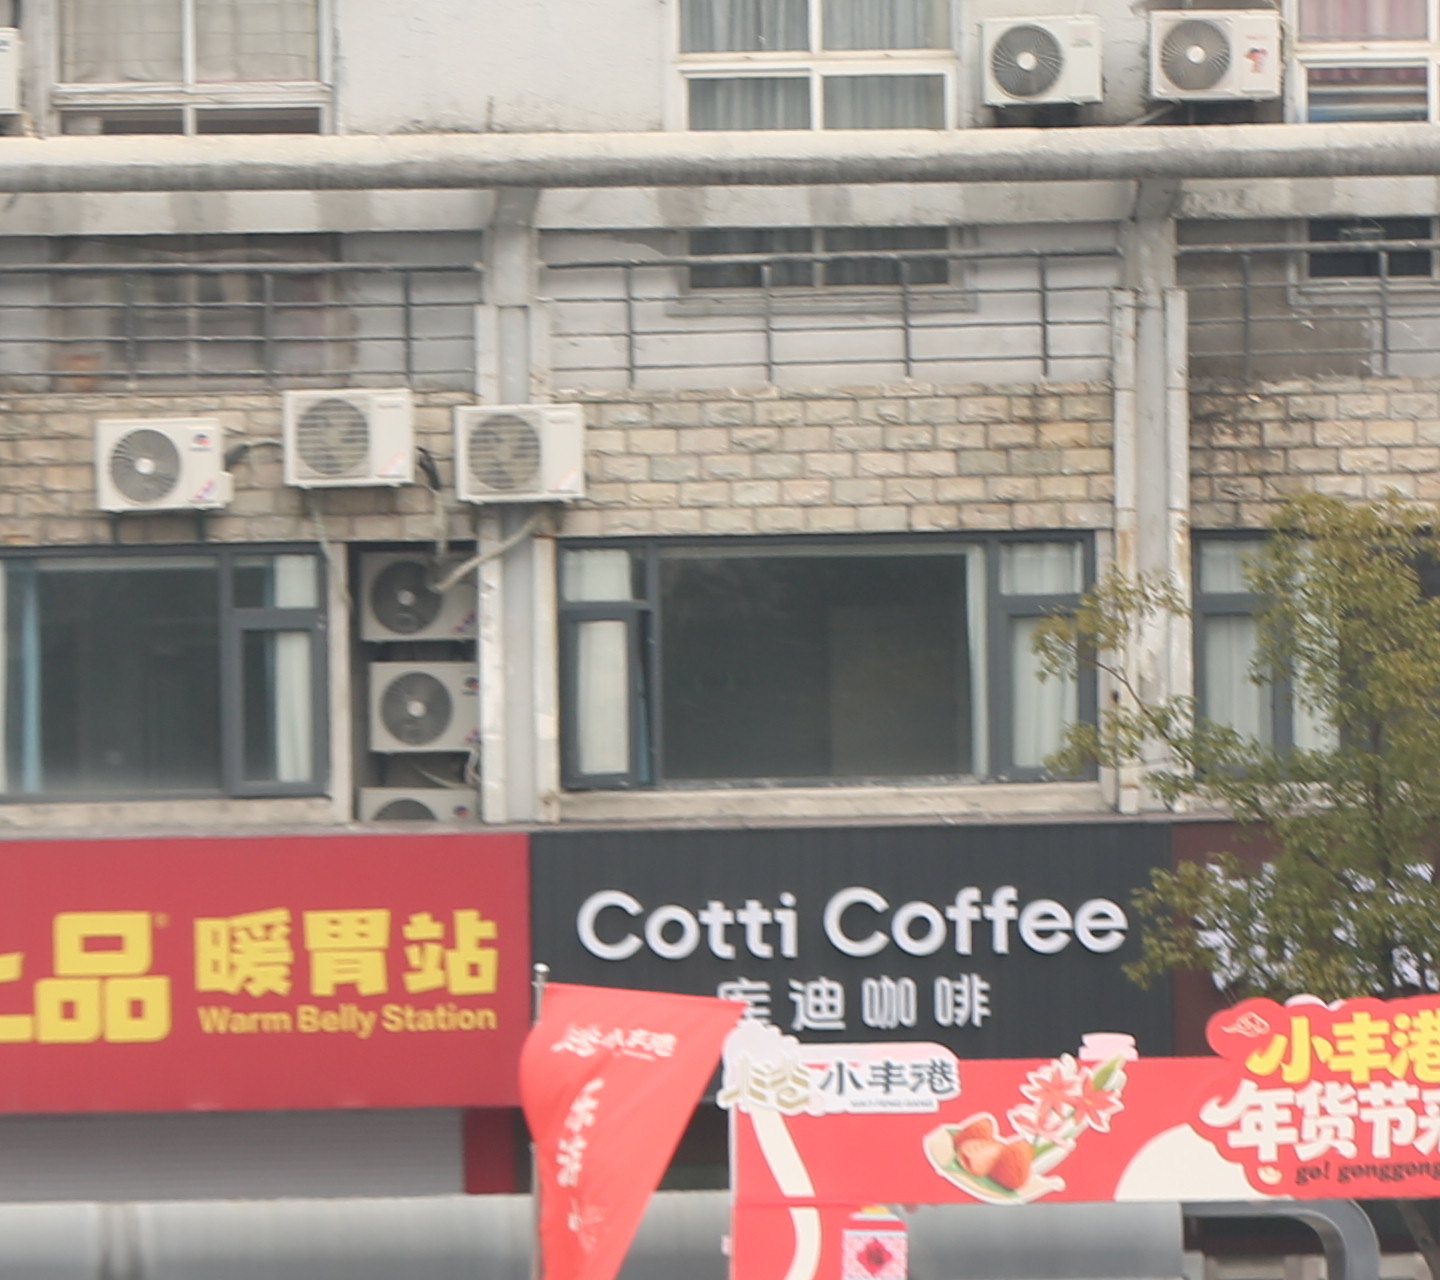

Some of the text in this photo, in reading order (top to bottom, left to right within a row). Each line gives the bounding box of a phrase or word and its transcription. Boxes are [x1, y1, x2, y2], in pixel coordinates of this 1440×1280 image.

[576, 888, 799, 961] Cotti
[823, 885, 1129, 958] Coffee
[192, 907, 499, 997] 暖胃站
[197, 1002, 497, 1039] Warm Belly Station
[817, 1057, 957, 1095] 小丰港
